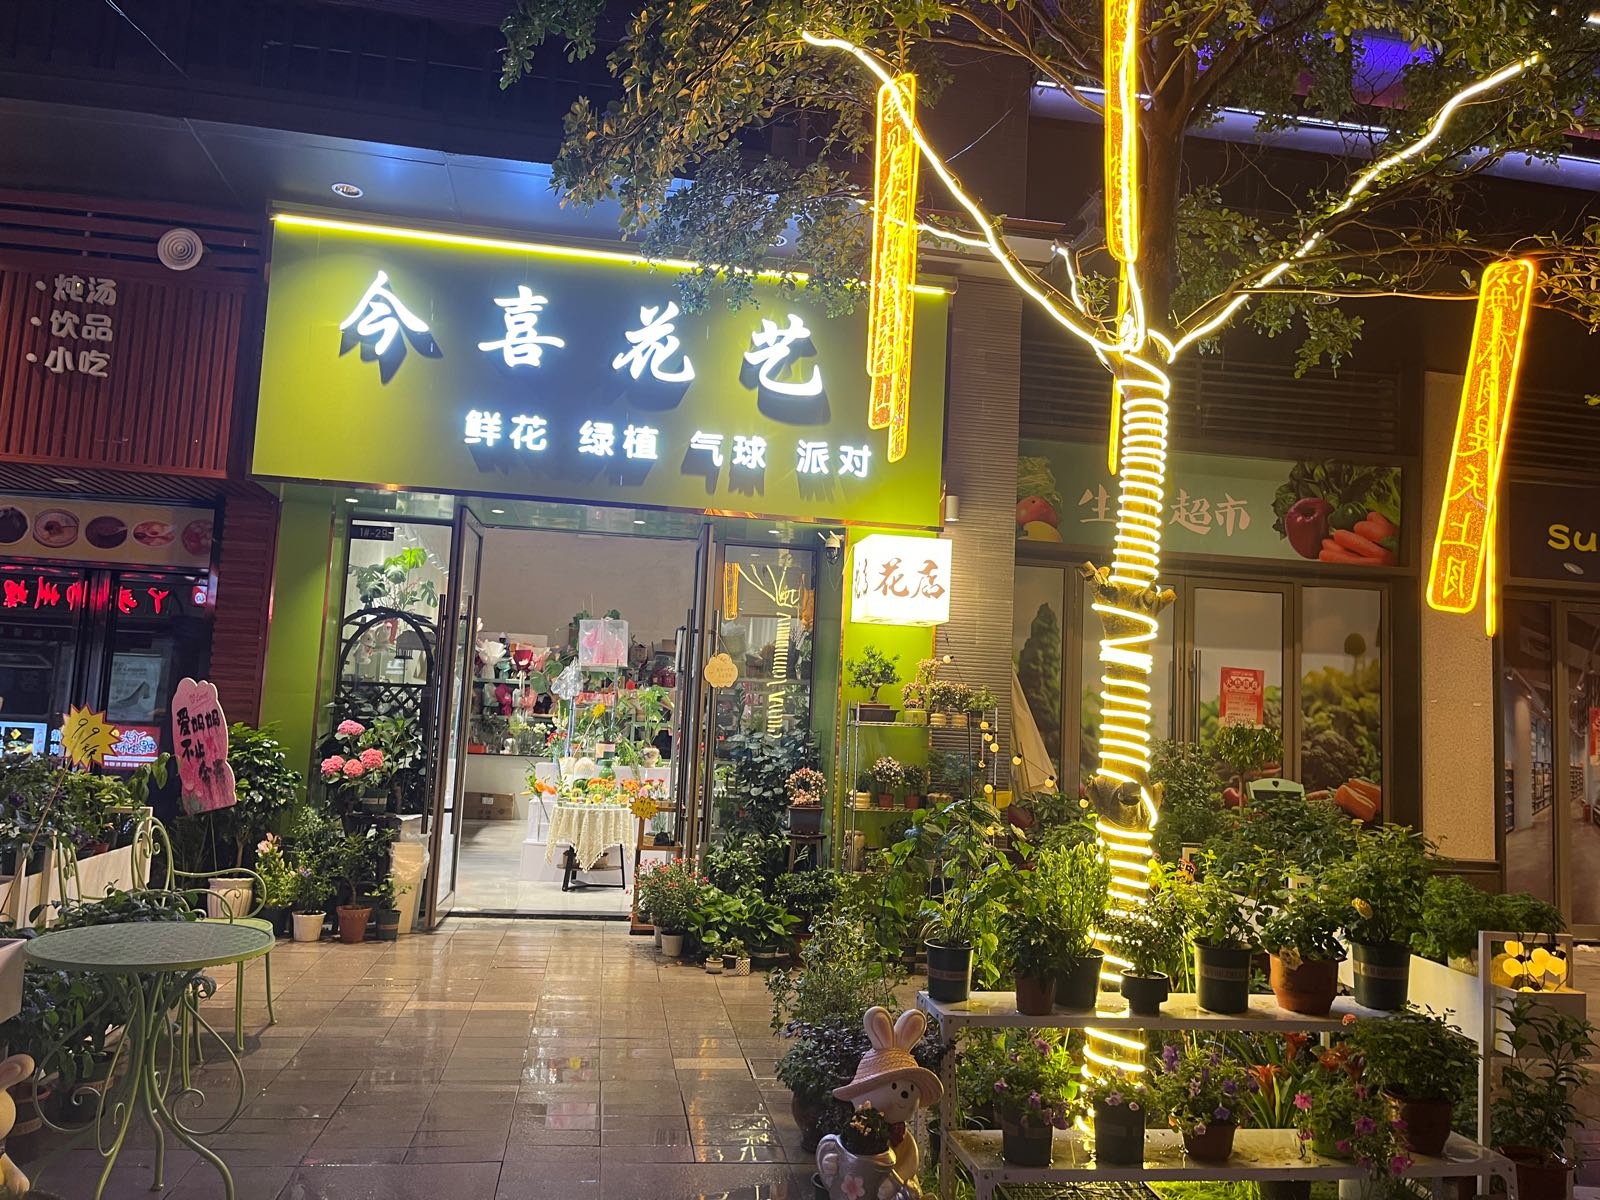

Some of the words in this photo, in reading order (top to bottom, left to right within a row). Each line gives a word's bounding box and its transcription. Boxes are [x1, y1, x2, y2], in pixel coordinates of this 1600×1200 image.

[53, 273, 117, 305] 炖汤
[50, 310, 113, 341] 饮品
[339, 269, 824, 397] 今喜花艺
[44, 346, 111, 378] 小吃
[464, 409, 548, 451] 鲜花
[578, 420, 659, 460] 绿植
[689, 430, 768, 470] 气球
[795, 438, 873, 479] 派对
[1078, 484, 1251, 537] 生超市
